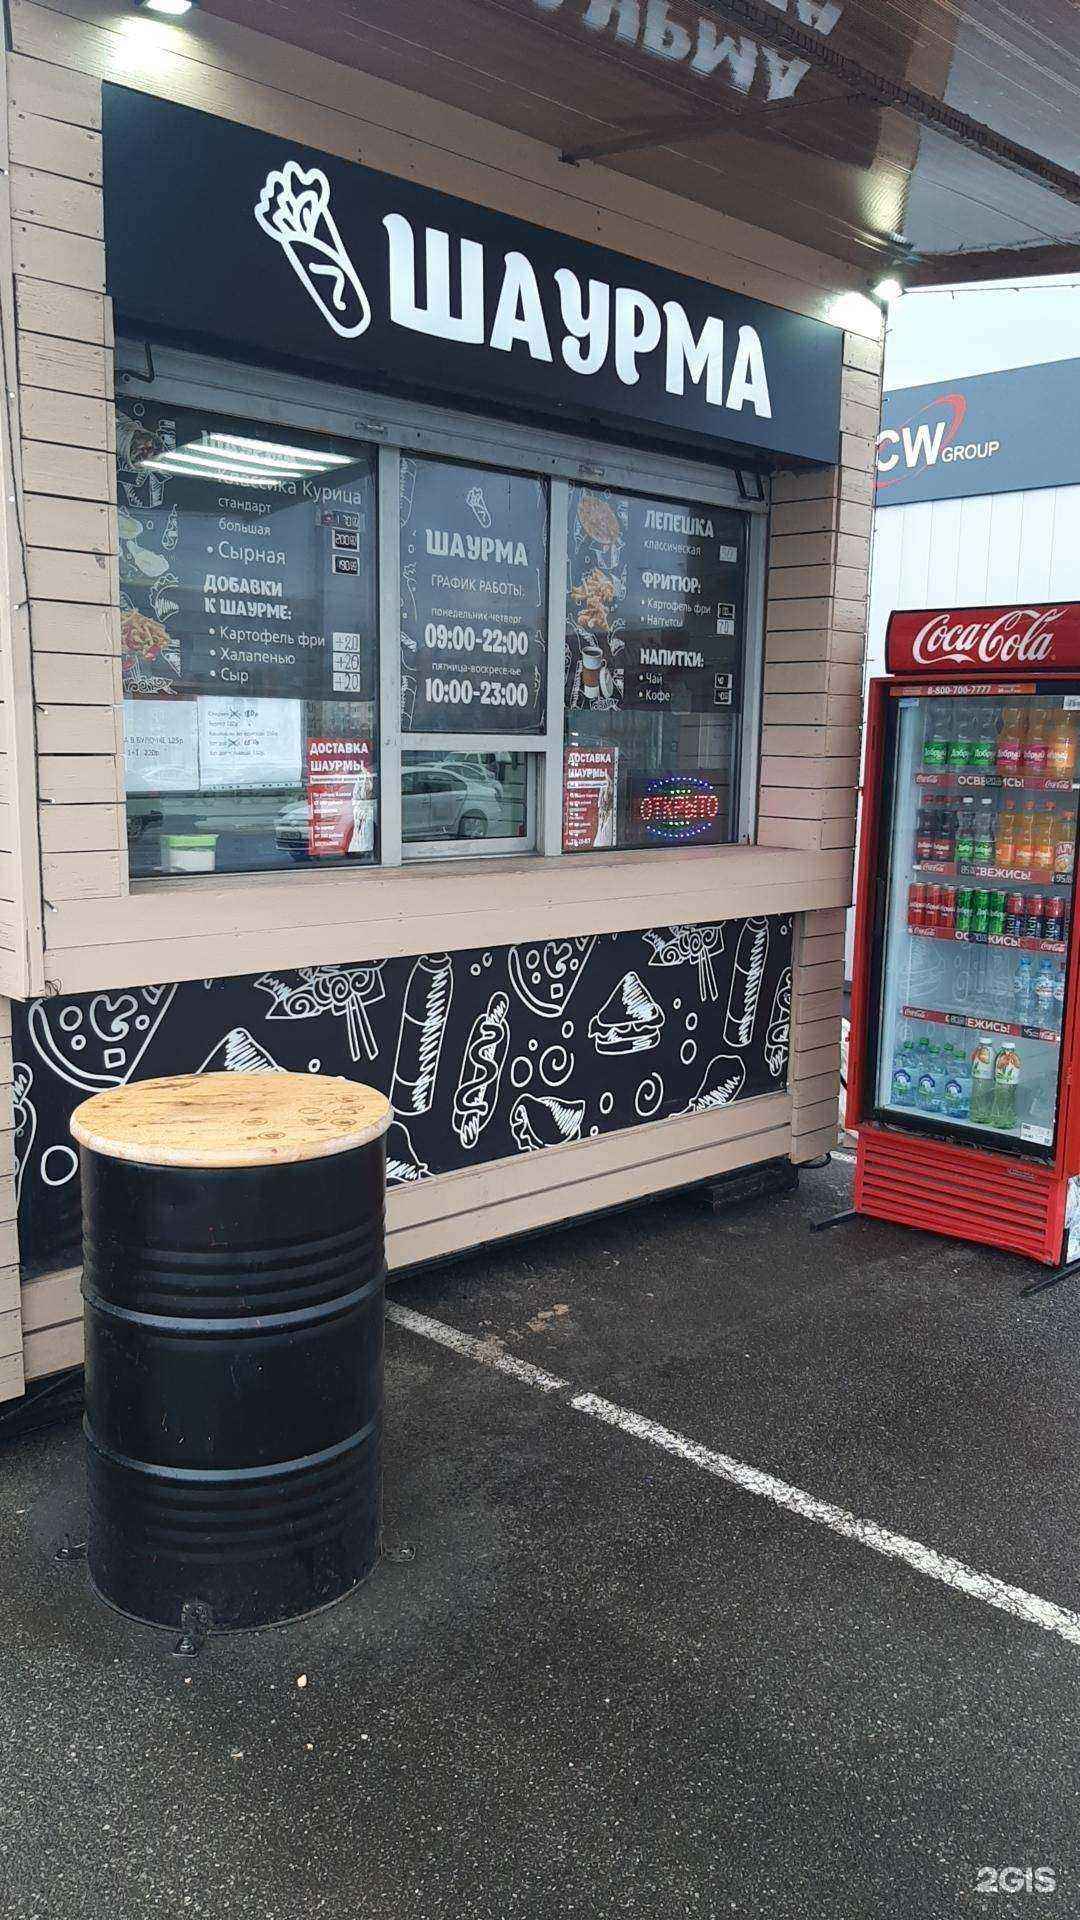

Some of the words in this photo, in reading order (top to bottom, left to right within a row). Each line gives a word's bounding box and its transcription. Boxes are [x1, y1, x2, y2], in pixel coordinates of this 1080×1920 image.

[382, 213, 772, 419] ШАУРМА
[941, 440, 1000, 463] GROUP
[302, 480, 362, 505] Курица
[218, 497, 272, 514] стандарт
[218, 517, 272, 536] большая
[218, 541, 286, 564] Сырная
[426, 528, 529, 566] ШАУРМА
[203, 574, 283, 597] ДОБАВКИ
[431, 574, 476, 591] ГРАФИК
[641, 571, 701, 594] ФРИТЮР:
[204, 597, 216, 613] К
[220, 598, 292, 620] ШАУРМЕ:
[648, 598, 692, 614] Картофель
[220, 626, 295, 646] Картофель
[298, 632, 326, 648] фри
[425, 623, 529, 656] 09:00-22:00
[912, 607, 1069, 665] Coca-Cola
[220, 647, 296, 665] Халапенью
[640, 648, 705, 668] НАПИТКИ:
[221, 668, 249, 685] Сыр
[646, 673, 663, 685] Чай
[425, 678, 529, 707] 10:00-23:00
[645, 690, 672, 703] Кофе
[310, 742, 369, 756] ДОСТАВКА
[568, 753, 612, 766] ДОСТАВКА
[310, 760, 365, 772] ШАУРМЫ
[568, 768, 608, 779] ШАУРМЫ
[640, 794, 719, 820] ОТКРЫТО
